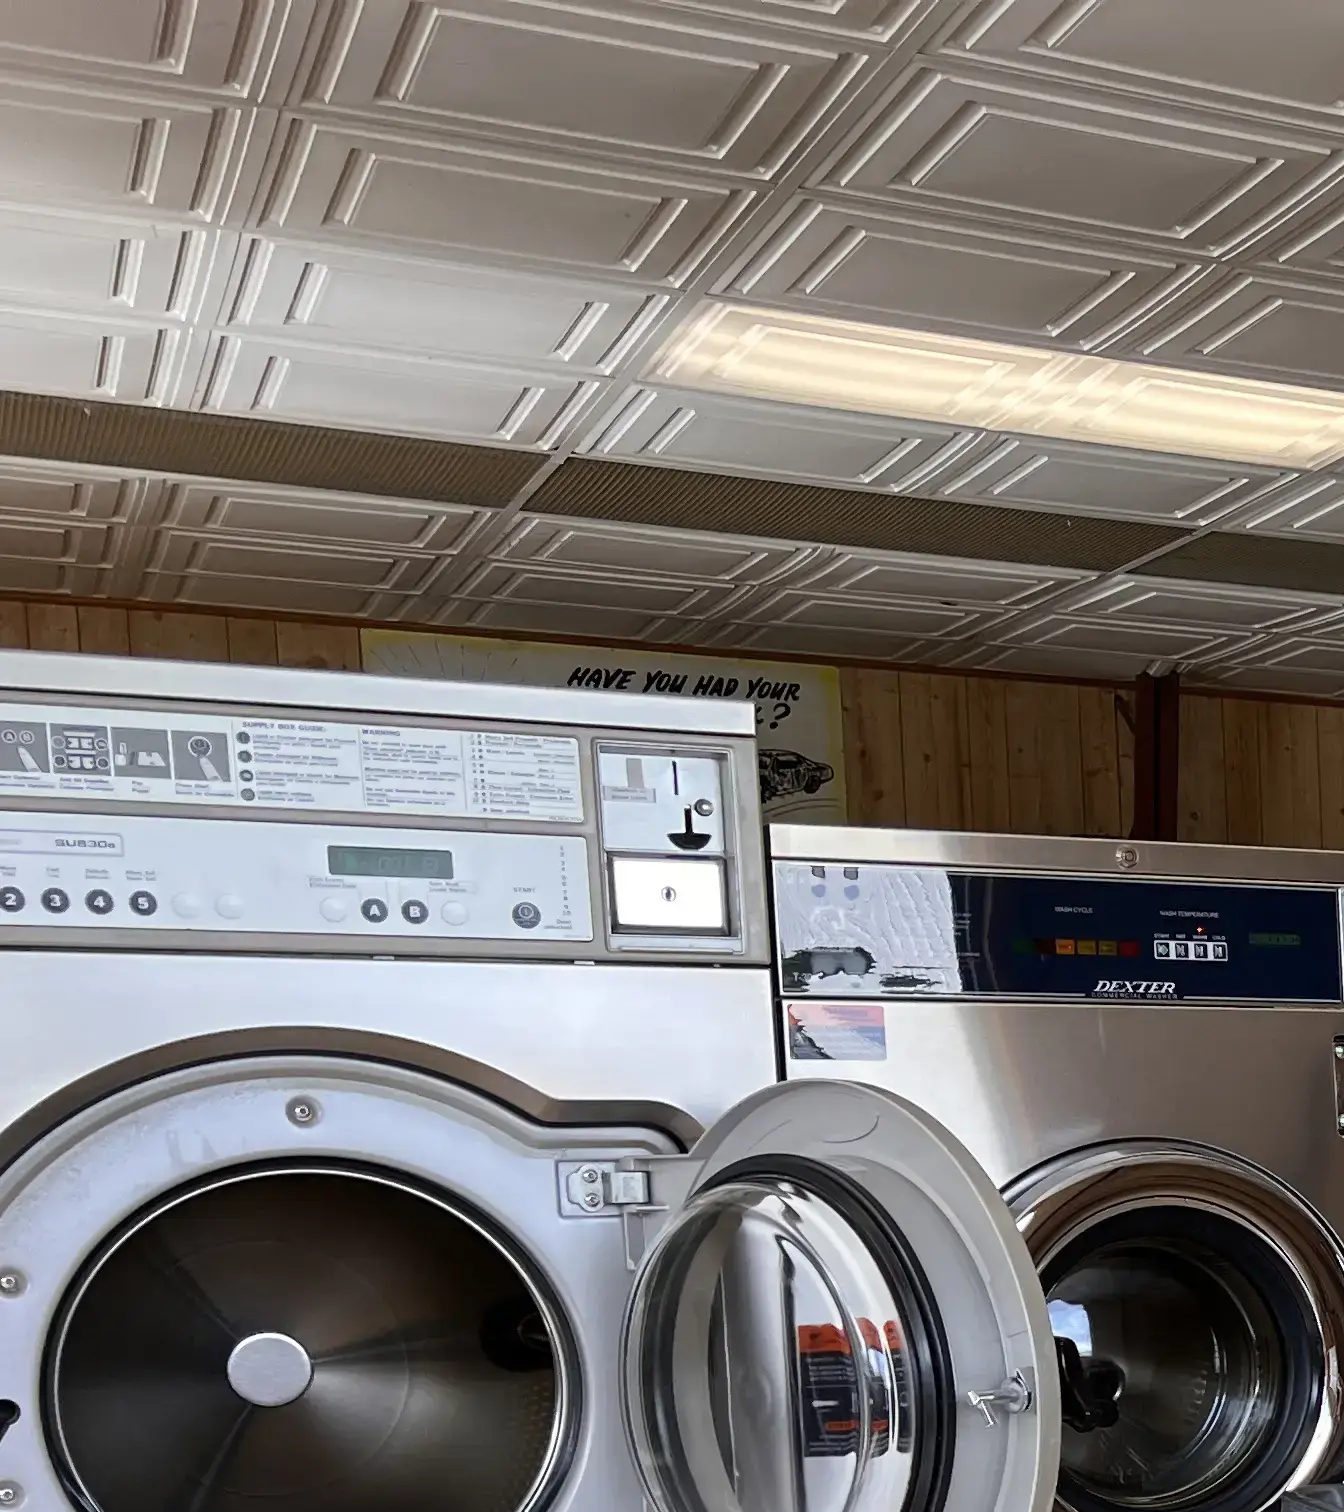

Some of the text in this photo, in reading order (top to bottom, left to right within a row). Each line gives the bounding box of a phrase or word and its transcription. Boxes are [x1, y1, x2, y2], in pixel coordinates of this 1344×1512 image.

[567, 667, 800, 701] HAVE YOU HAD YOUR
[4, 893, 17, 906] 2
[49, 894, 61, 907] 3
[93, 896, 105, 908] 4
[137, 897, 149, 909] 5
[369, 905, 381, 917] A
[409, 906, 421, 917] B
[1094, 980, 1176, 993] DEXTER
